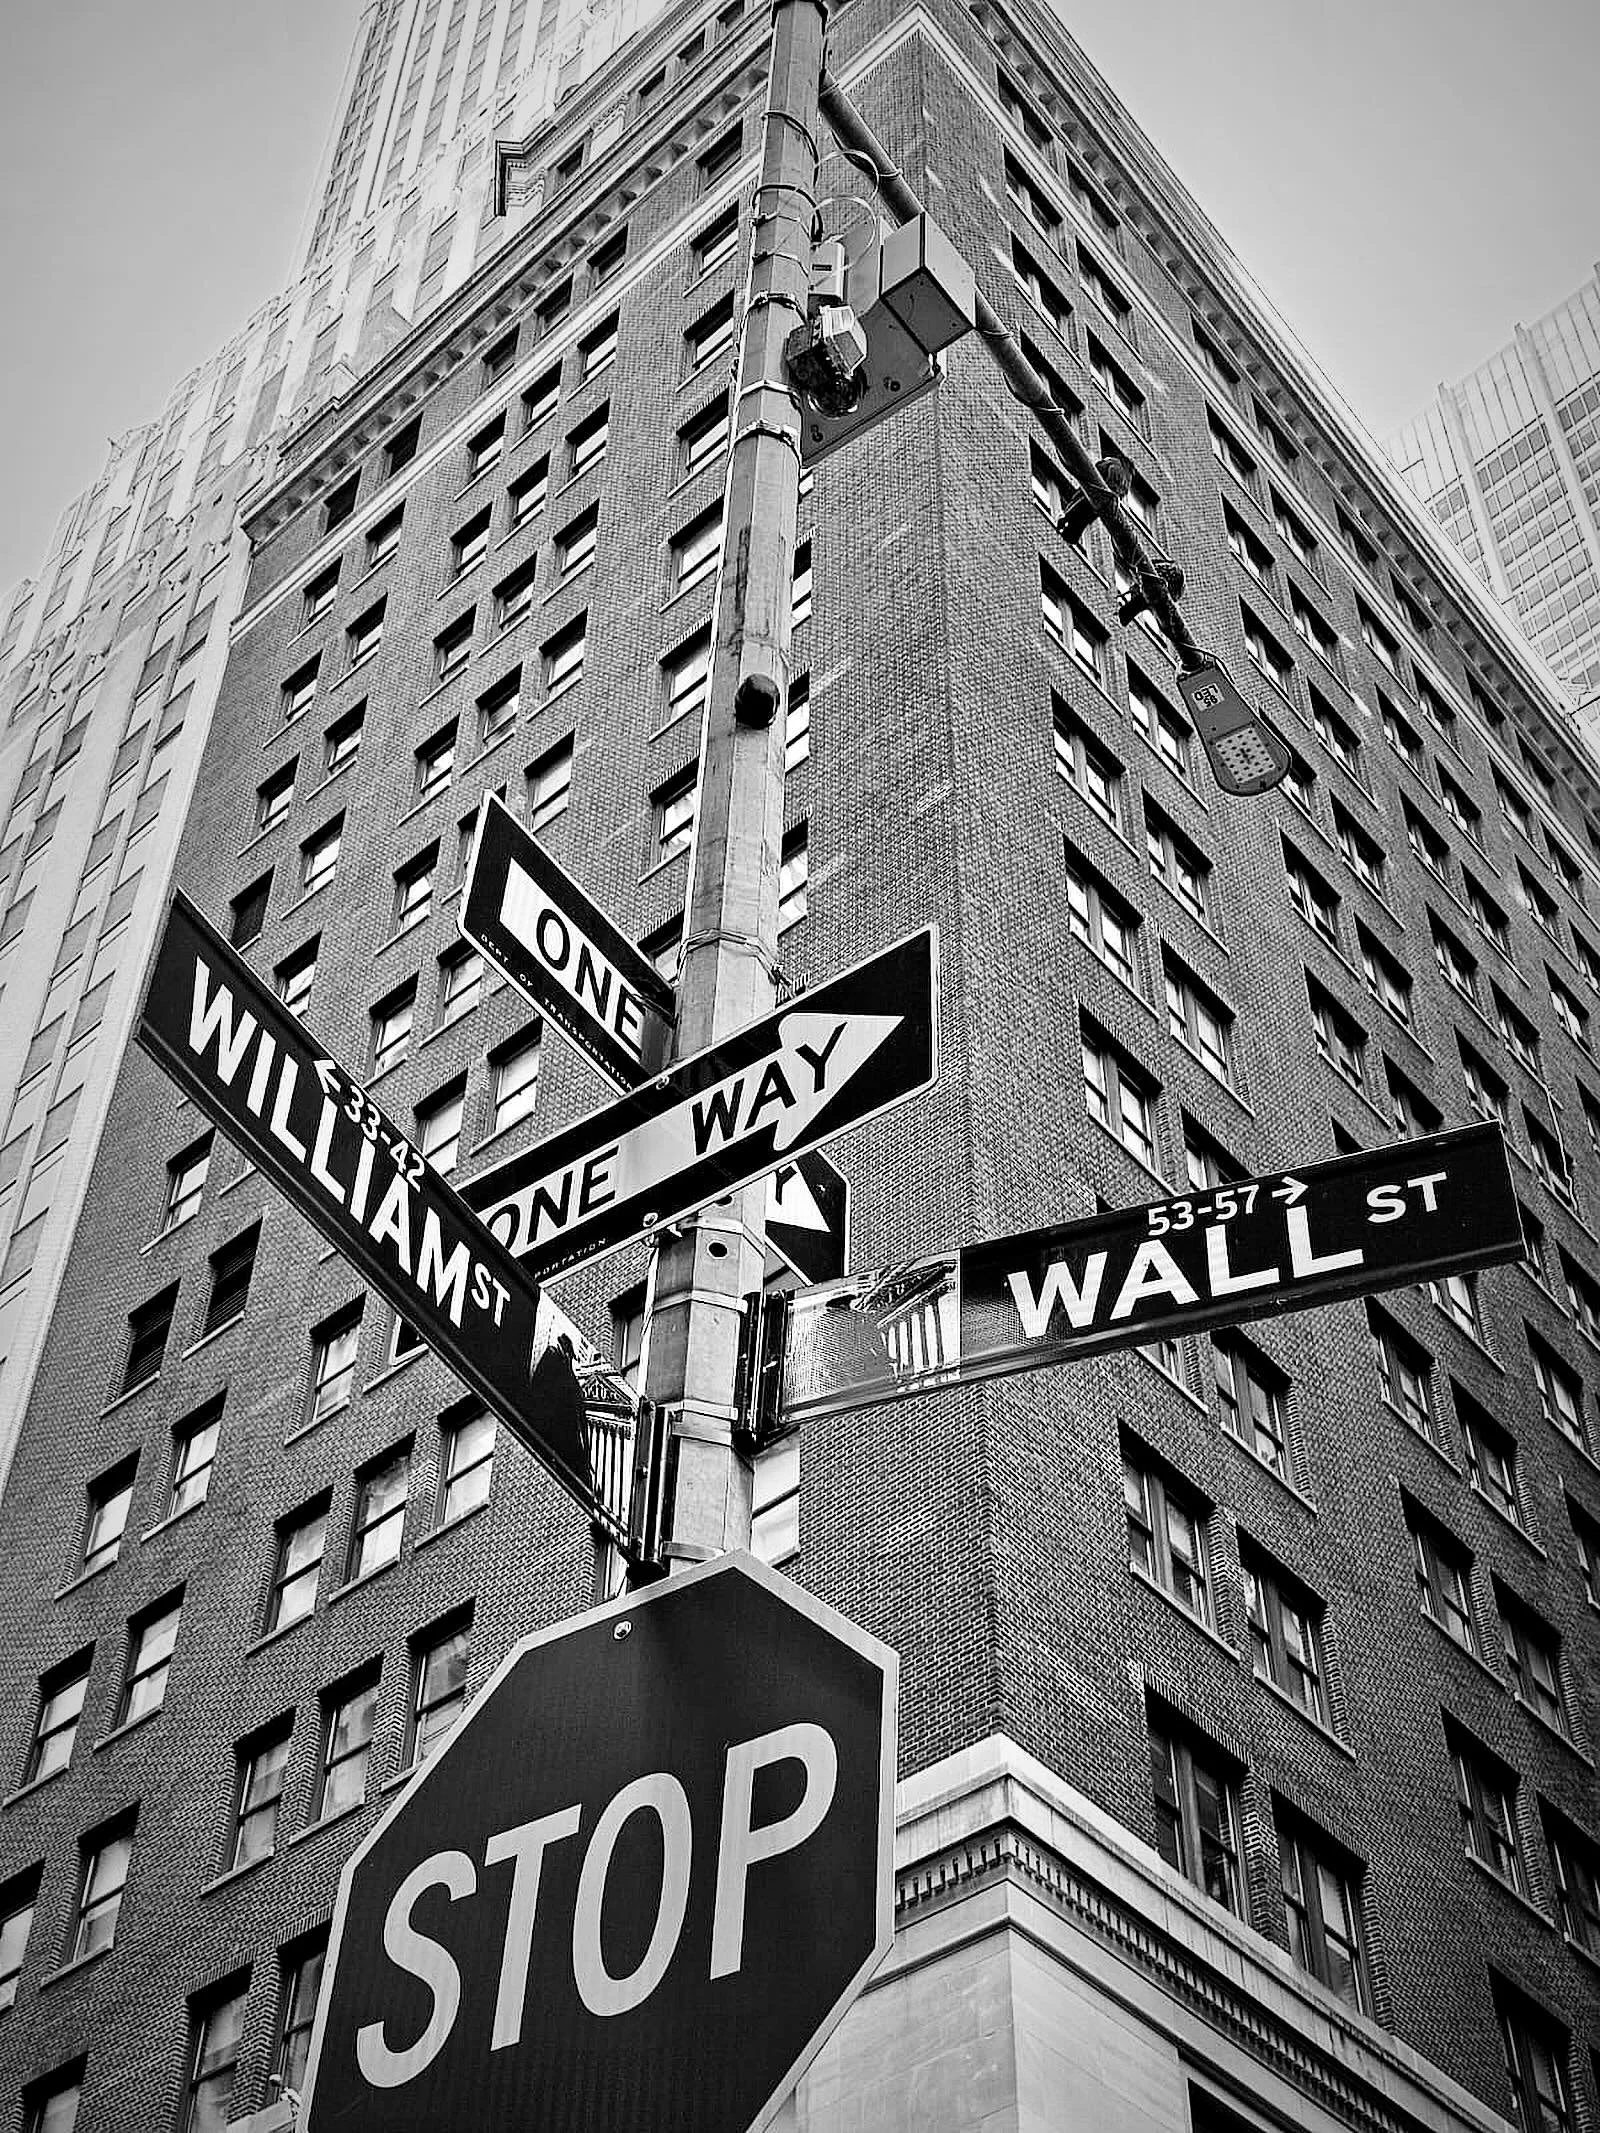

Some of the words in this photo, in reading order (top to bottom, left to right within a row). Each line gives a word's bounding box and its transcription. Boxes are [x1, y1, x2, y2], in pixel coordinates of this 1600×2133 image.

[1194, 685, 1218, 701] LED
[536, 908, 646, 1060] ONE
[189, 956, 471, 1329] WILLIAM
[470, 1262, 512, 1327] ST
[343, 1084, 426, 1193] 33-42
[486, 1144, 620, 1250] ONE
[691, 1021, 848, 1157] WAY
[1147, 1184, 1260, 1236] 53-57
[1008, 1204, 1364, 1339] WALL
[1367, 1171, 1447, 1223] ST
[356, 1722, 838, 2088] STOP
